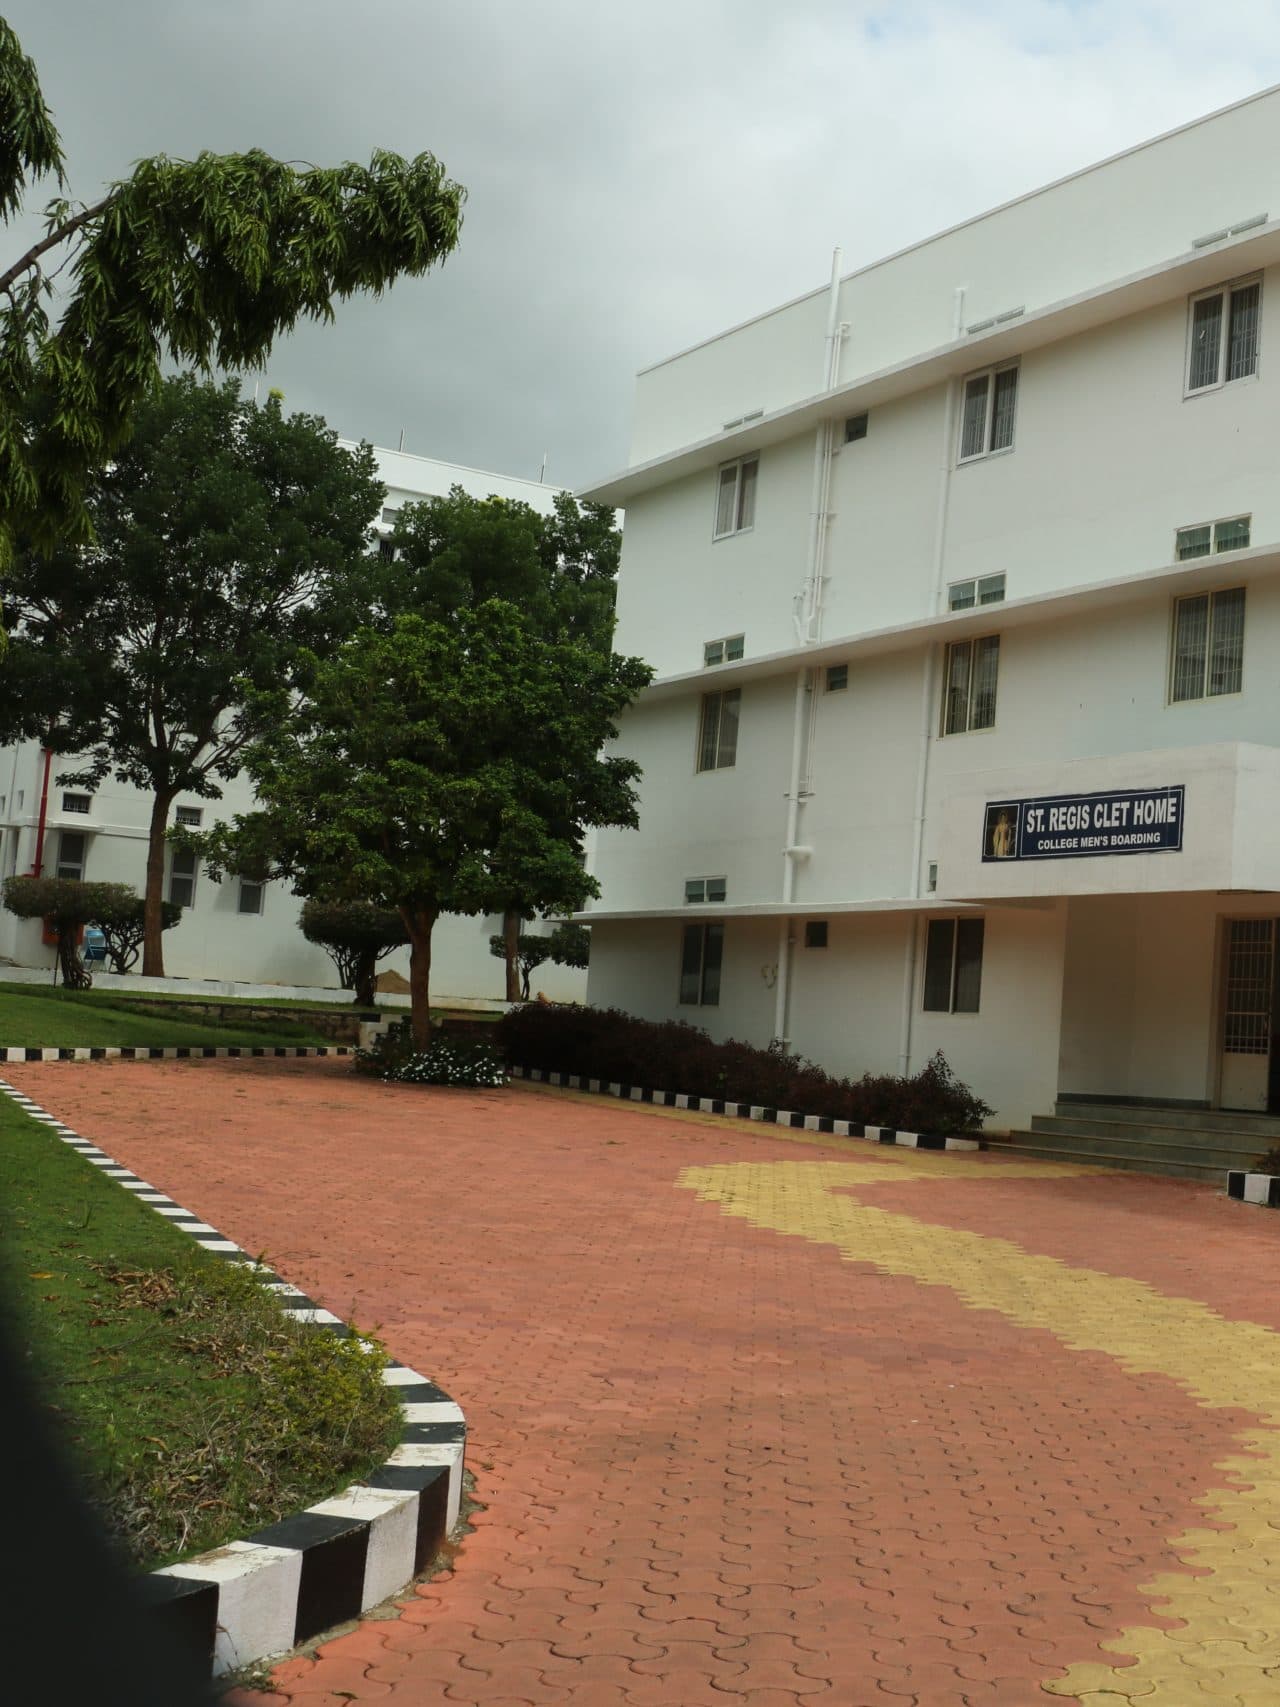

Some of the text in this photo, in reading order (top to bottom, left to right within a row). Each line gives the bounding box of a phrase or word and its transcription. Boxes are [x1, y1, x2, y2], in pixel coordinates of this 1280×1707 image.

[1026, 797, 1177, 833] ST. REGIS CLET HOME
[1038, 832, 1161, 850] COLLEGE MEN'S BOARDING
